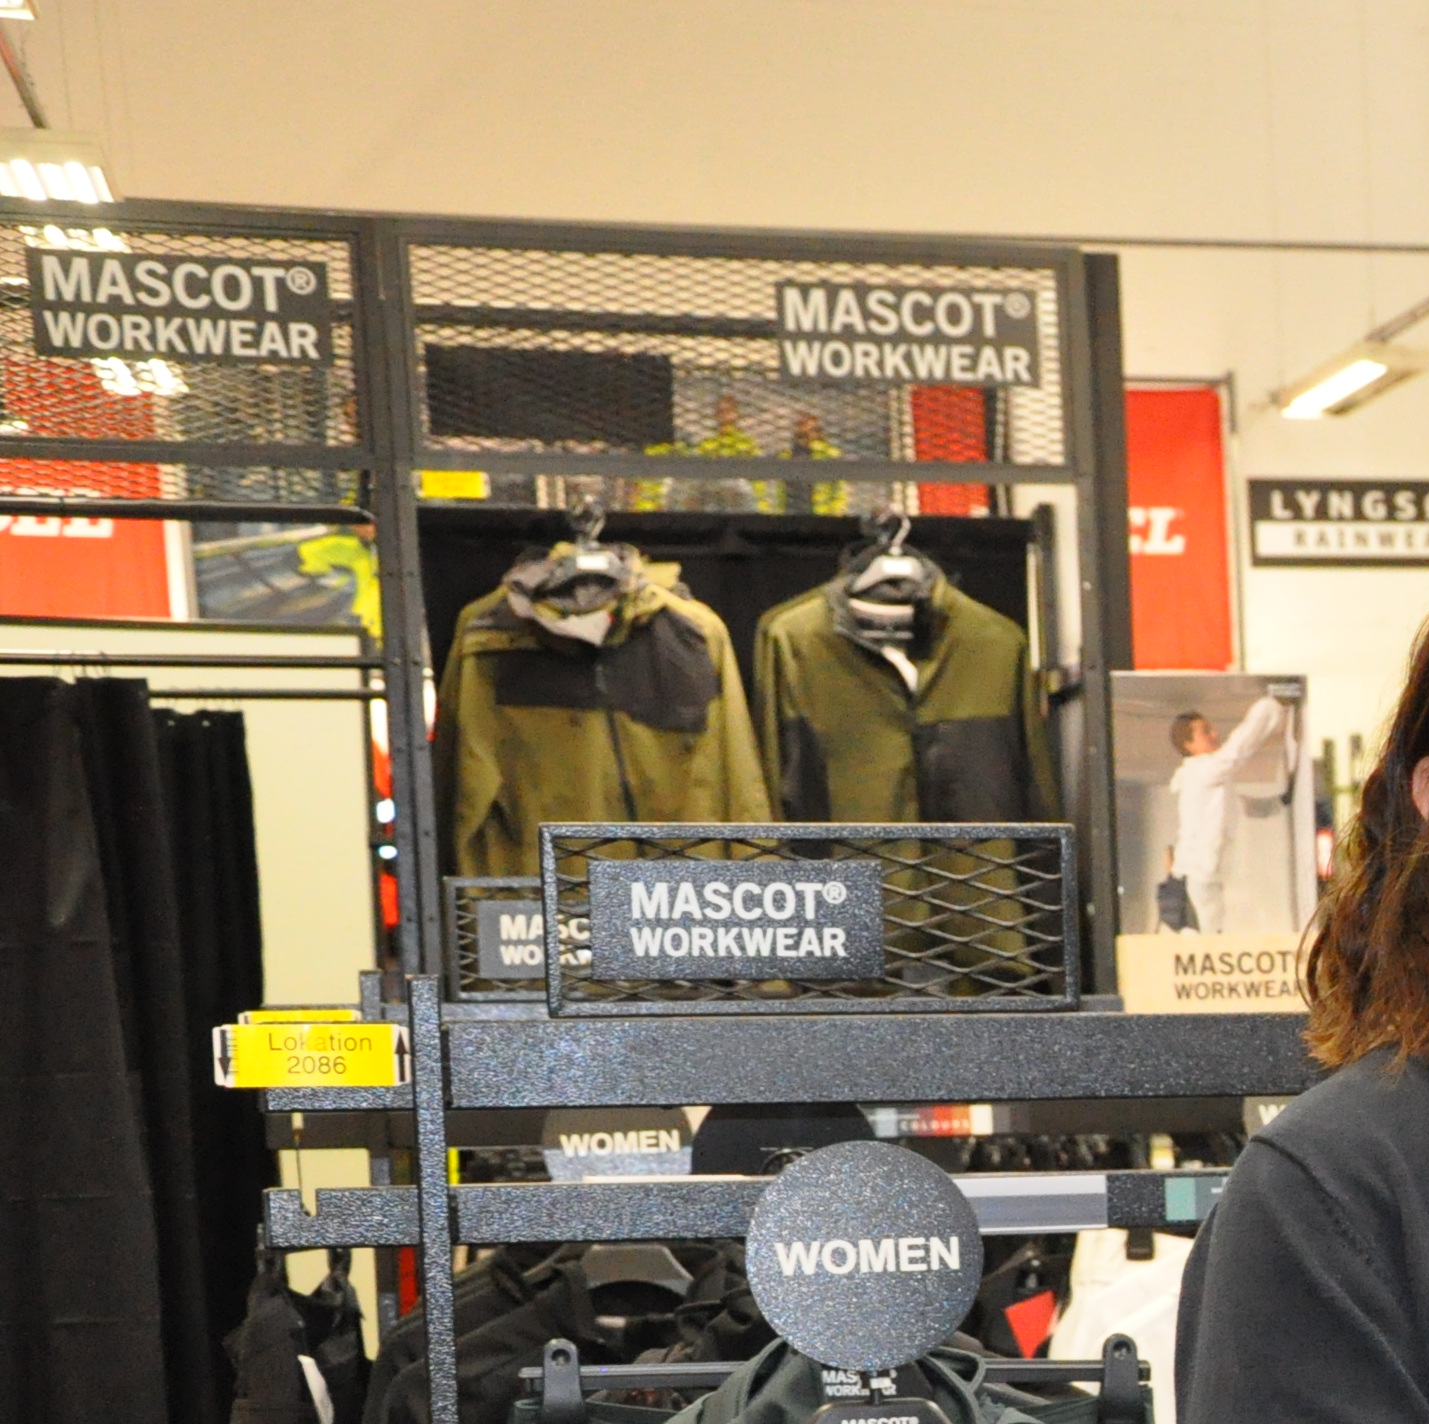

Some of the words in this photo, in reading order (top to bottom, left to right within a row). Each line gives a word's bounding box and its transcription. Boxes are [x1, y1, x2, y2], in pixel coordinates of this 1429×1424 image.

[43, 310, 321, 360] WORKWEAR
[782, 340, 1032, 384] WORKWEAR
[631, 926, 848, 957] WORKWEAR
[268, 1033, 372, 1051] Lokation
[287, 1056, 347, 1075] 2086
[560, 1129, 680, 1157] WOMEN
[774, 1236, 960, 1276] WOMEN
